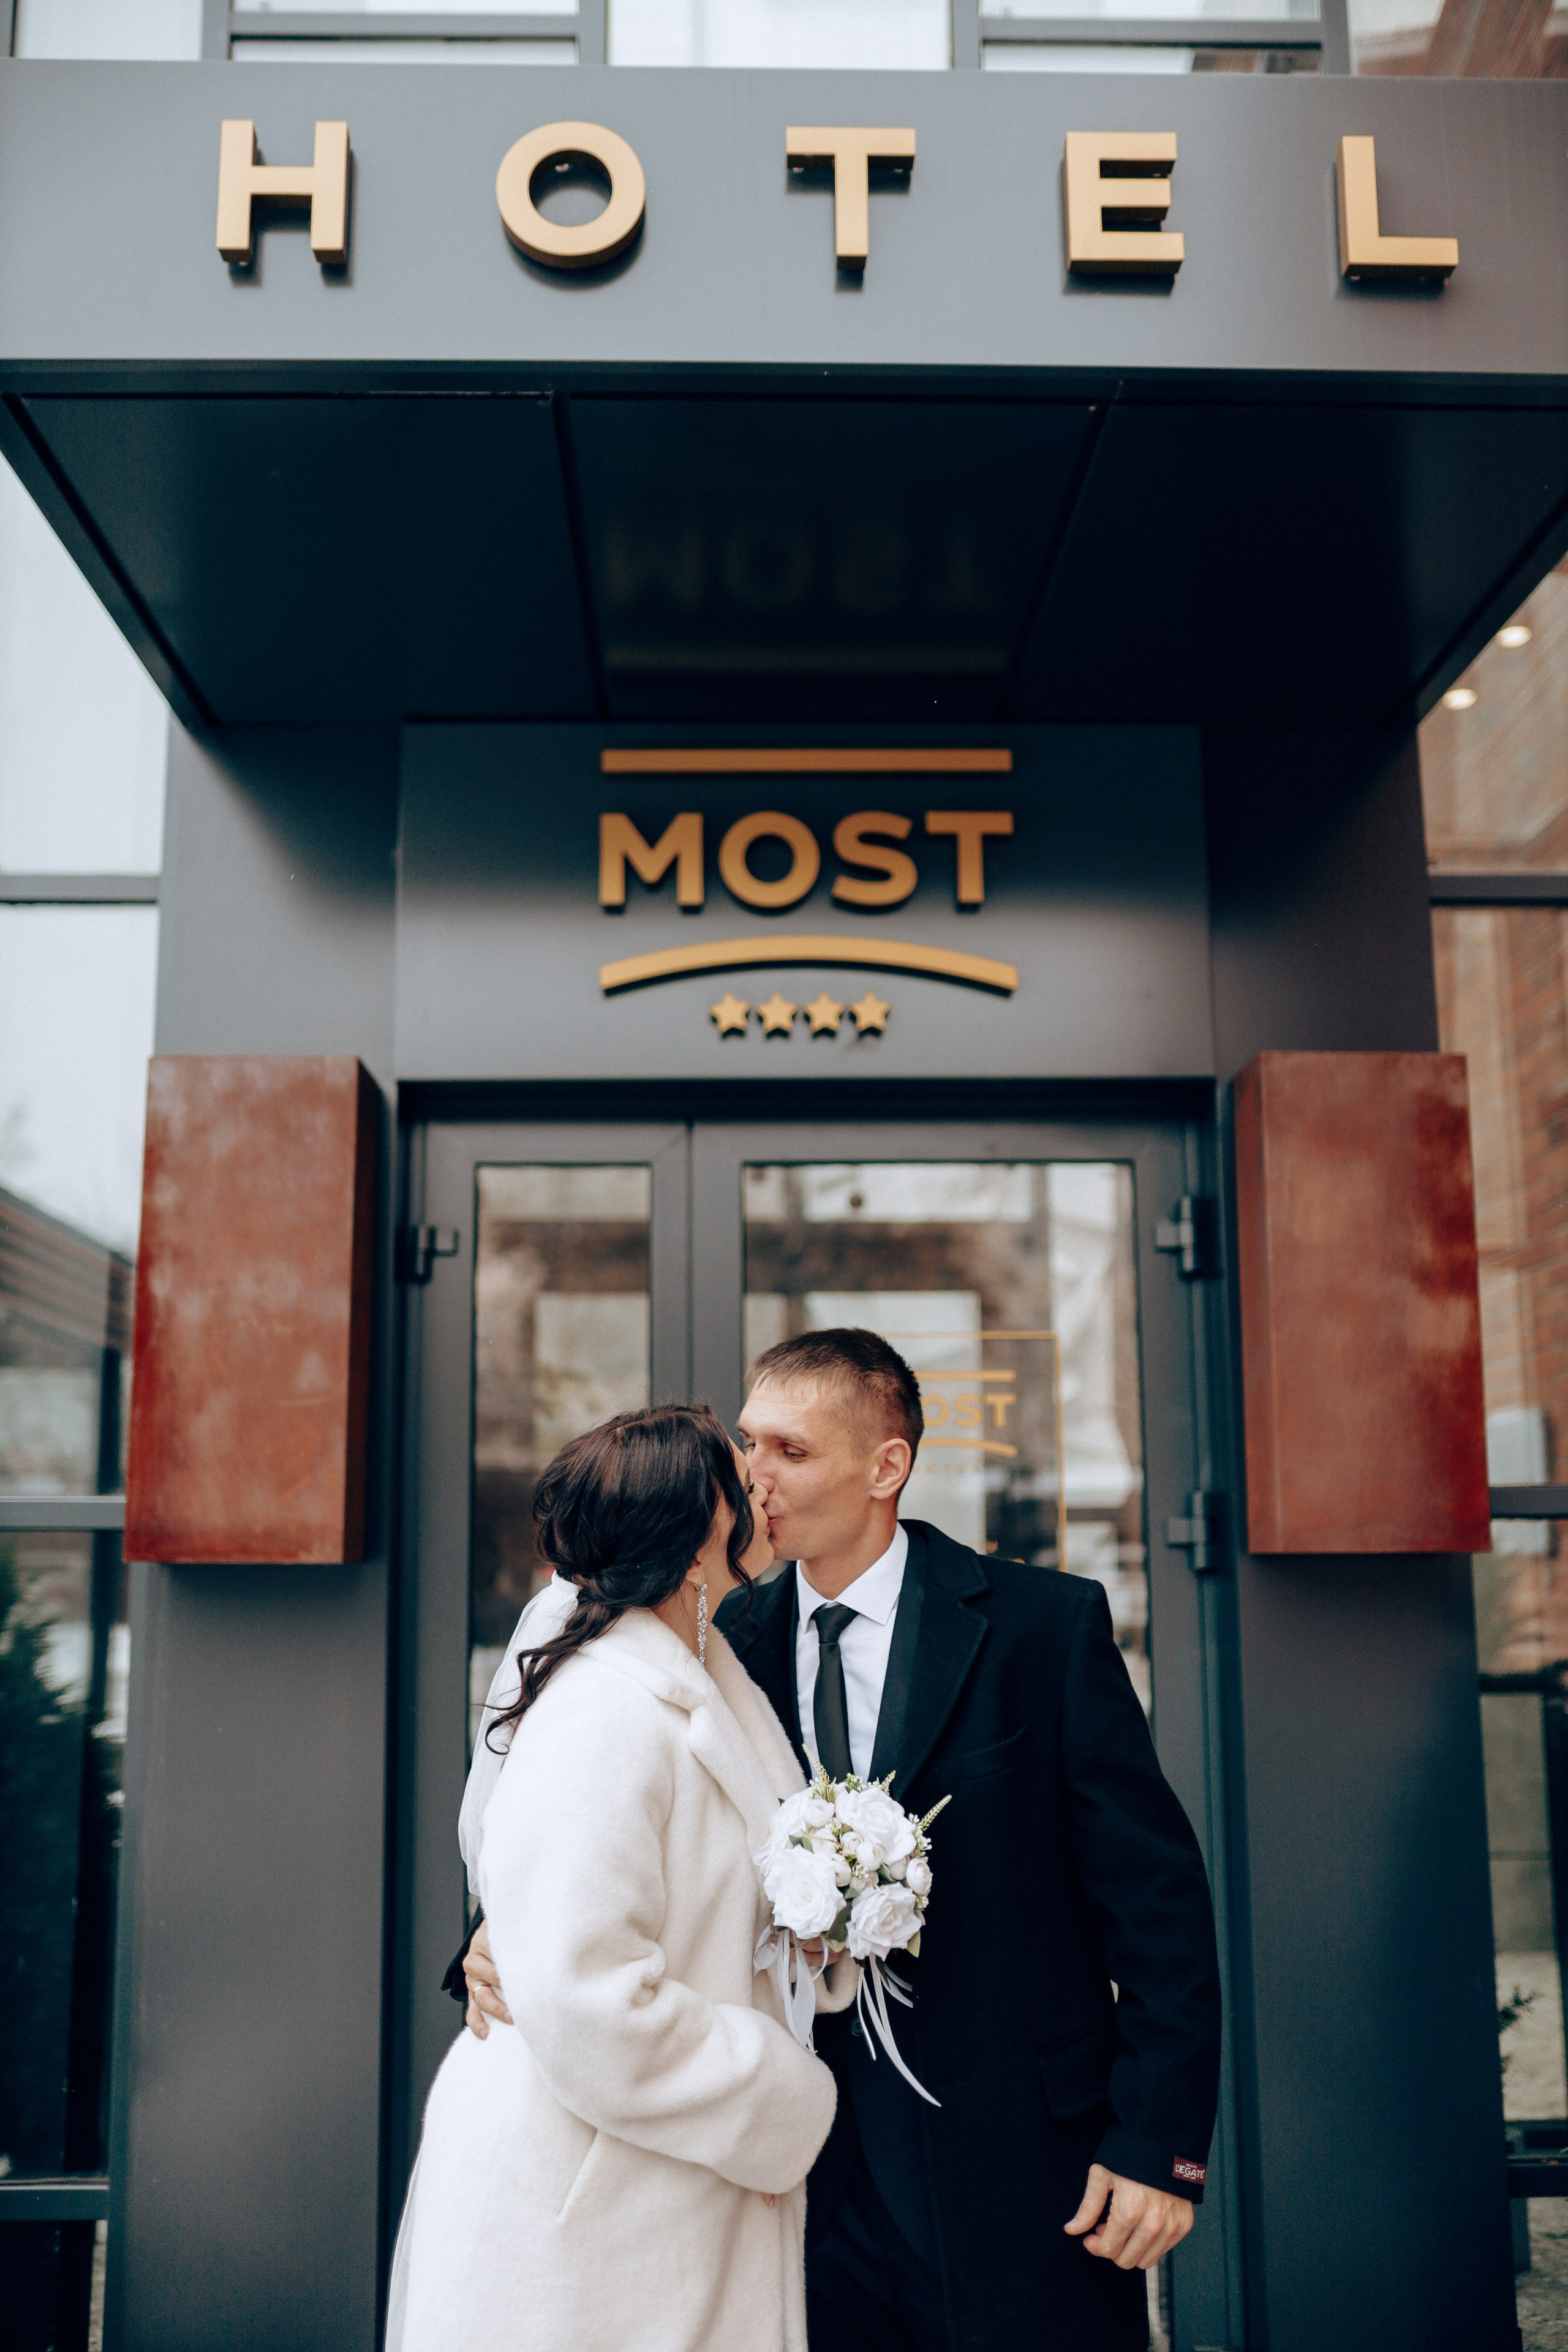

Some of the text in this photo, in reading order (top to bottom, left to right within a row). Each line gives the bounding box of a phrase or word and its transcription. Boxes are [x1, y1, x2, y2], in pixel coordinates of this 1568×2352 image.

[216, 119, 1460, 276] HOTEL
[599, 810, 1015, 909] MOST
[921, 1393, 1016, 1428] OST
